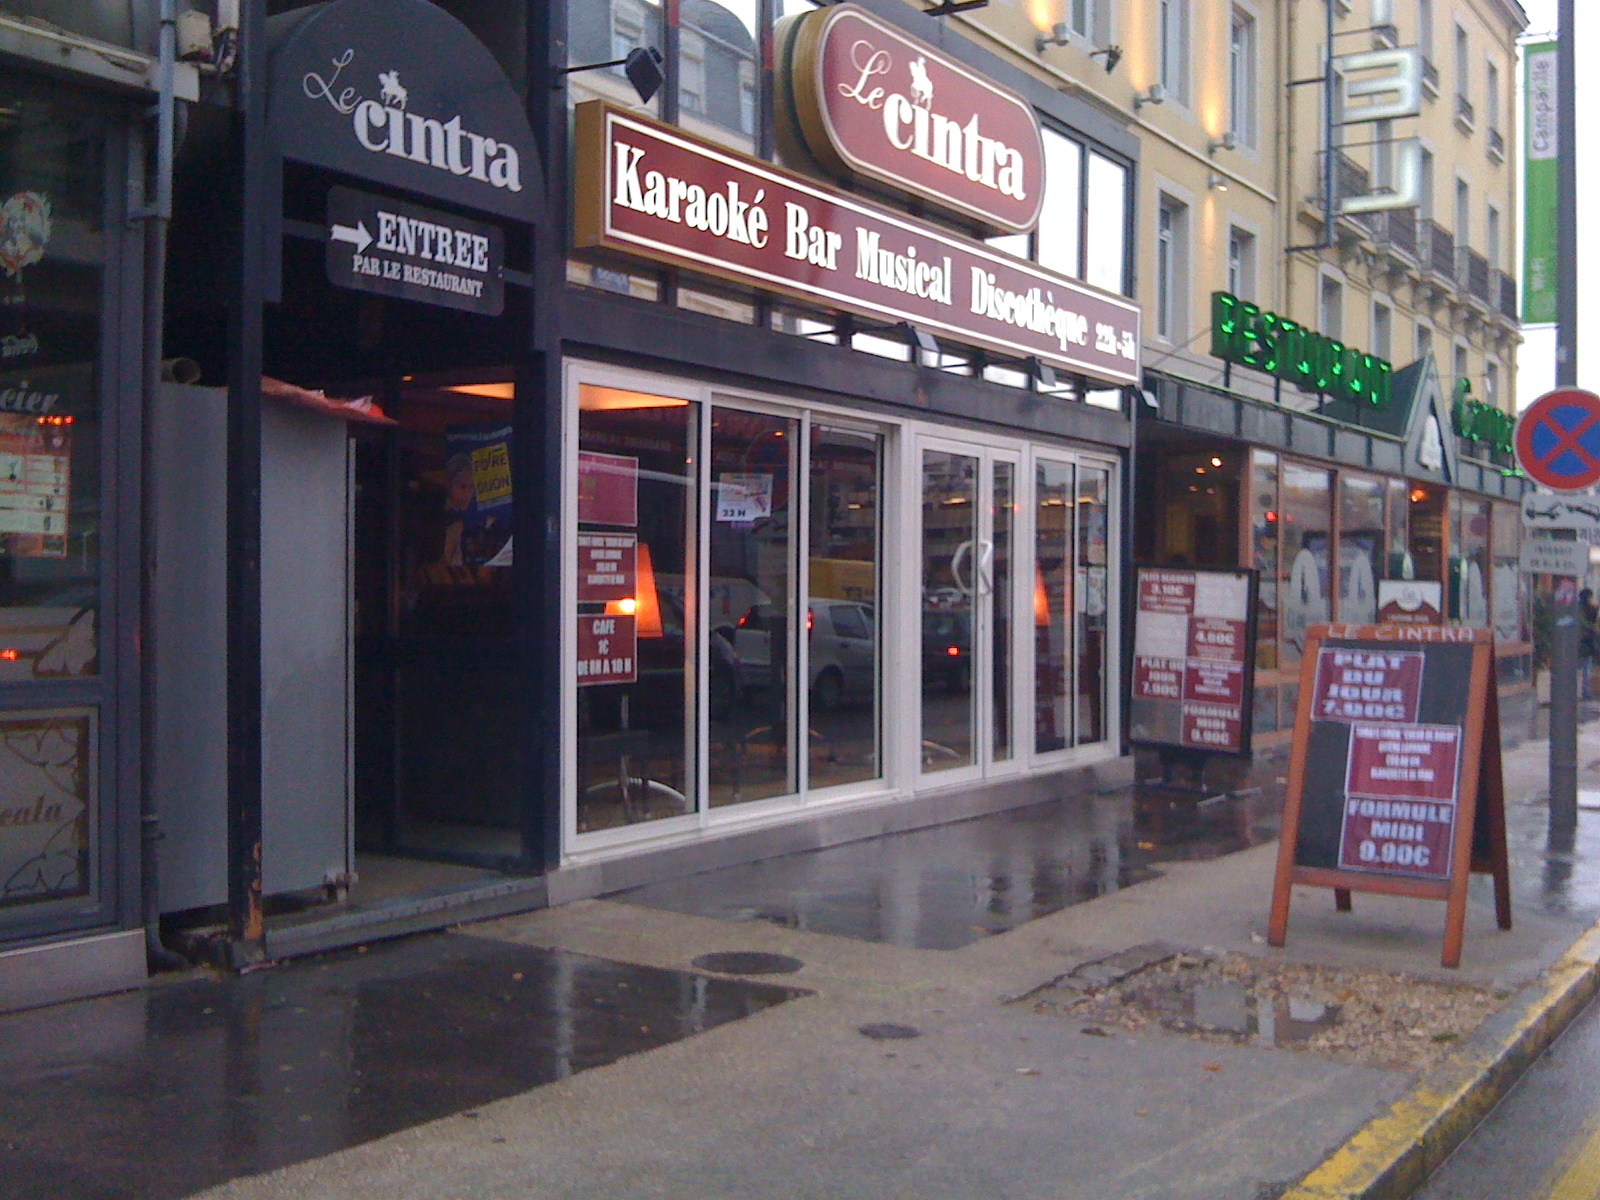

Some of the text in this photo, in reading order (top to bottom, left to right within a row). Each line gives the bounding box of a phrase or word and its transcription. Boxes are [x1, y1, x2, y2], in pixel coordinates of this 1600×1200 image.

[303, 49, 363, 114] Le
[838, 40, 892, 109] Le
[377, 211, 488, 272] ENTREE
[614, 141, 768, 249] Karaoké
[785, 202, 842, 270] Bar
[855, 227, 951, 305] Musical
[971, 267, 1087, 351] Discothèque
[353, 254, 483, 298] PAR LE RESTAURANT
[723, 509, 736, 517] 22
[1328, 624, 1474, 642] LE CINTRA
[1334, 653, 1406, 670] PLAT
[1342, 669, 1385, 685] DU
[1328, 683, 1403, 702] JOUR
[1348, 799, 1451, 823] FORMULE
[1370, 820, 1424, 842] MIDI
